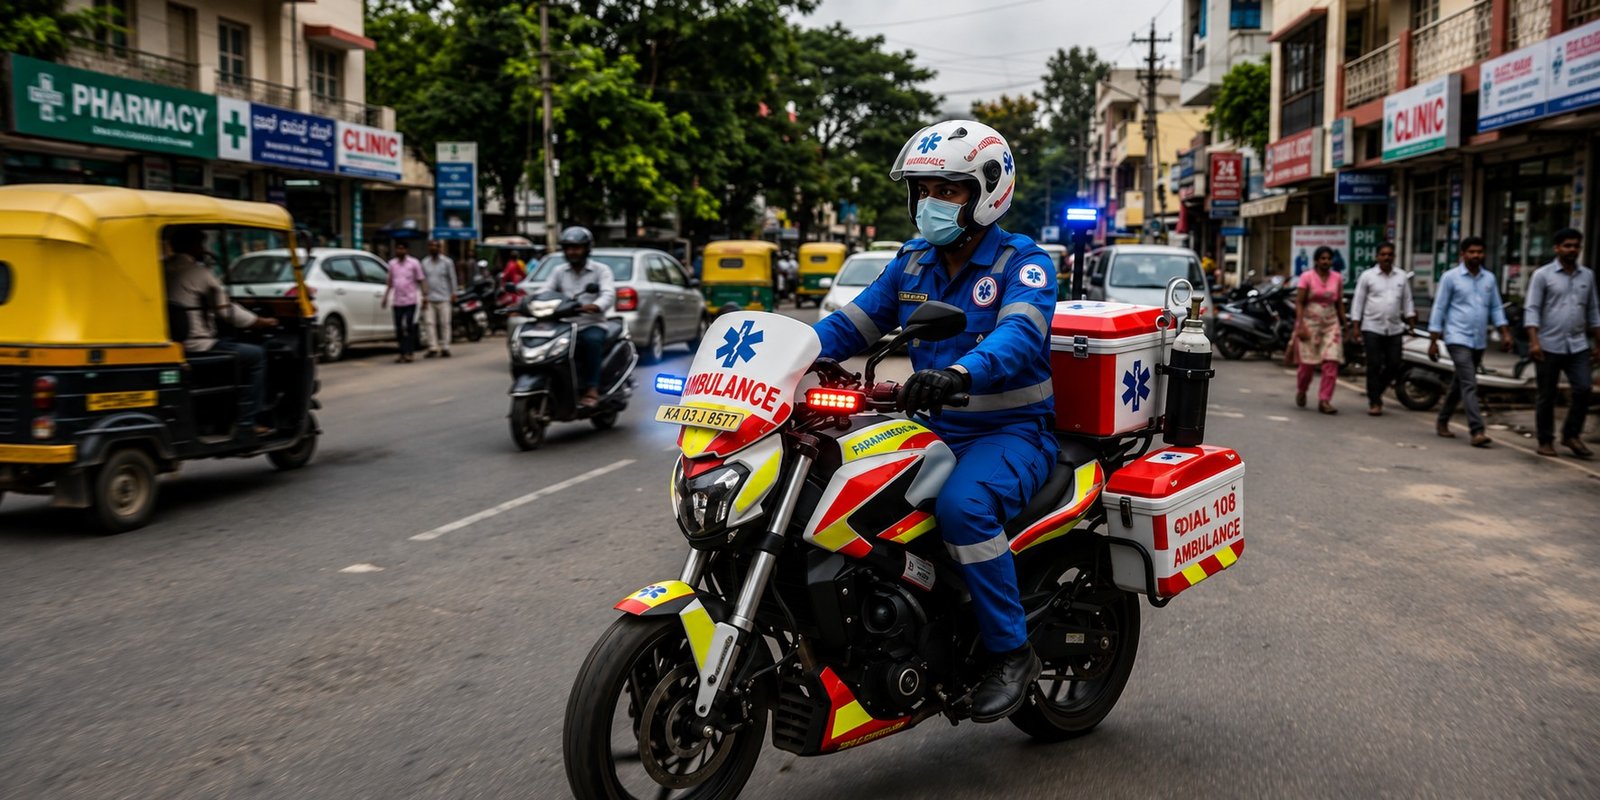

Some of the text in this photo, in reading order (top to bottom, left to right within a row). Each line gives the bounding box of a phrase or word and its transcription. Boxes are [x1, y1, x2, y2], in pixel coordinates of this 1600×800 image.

[72, 83, 208, 135] PHARMACY
[1395, 97, 1444, 143] CLINIC
[343, 128, 398, 157] CLINIC
[1217, 160, 1236, 176] 24
[682, 372, 781, 413] AMBULANCE
[663, 407, 737, 427] KA 03 J 8577
[1213, 492, 1236, 519] 108
[1174, 516, 1241, 568] AMBULANCE
